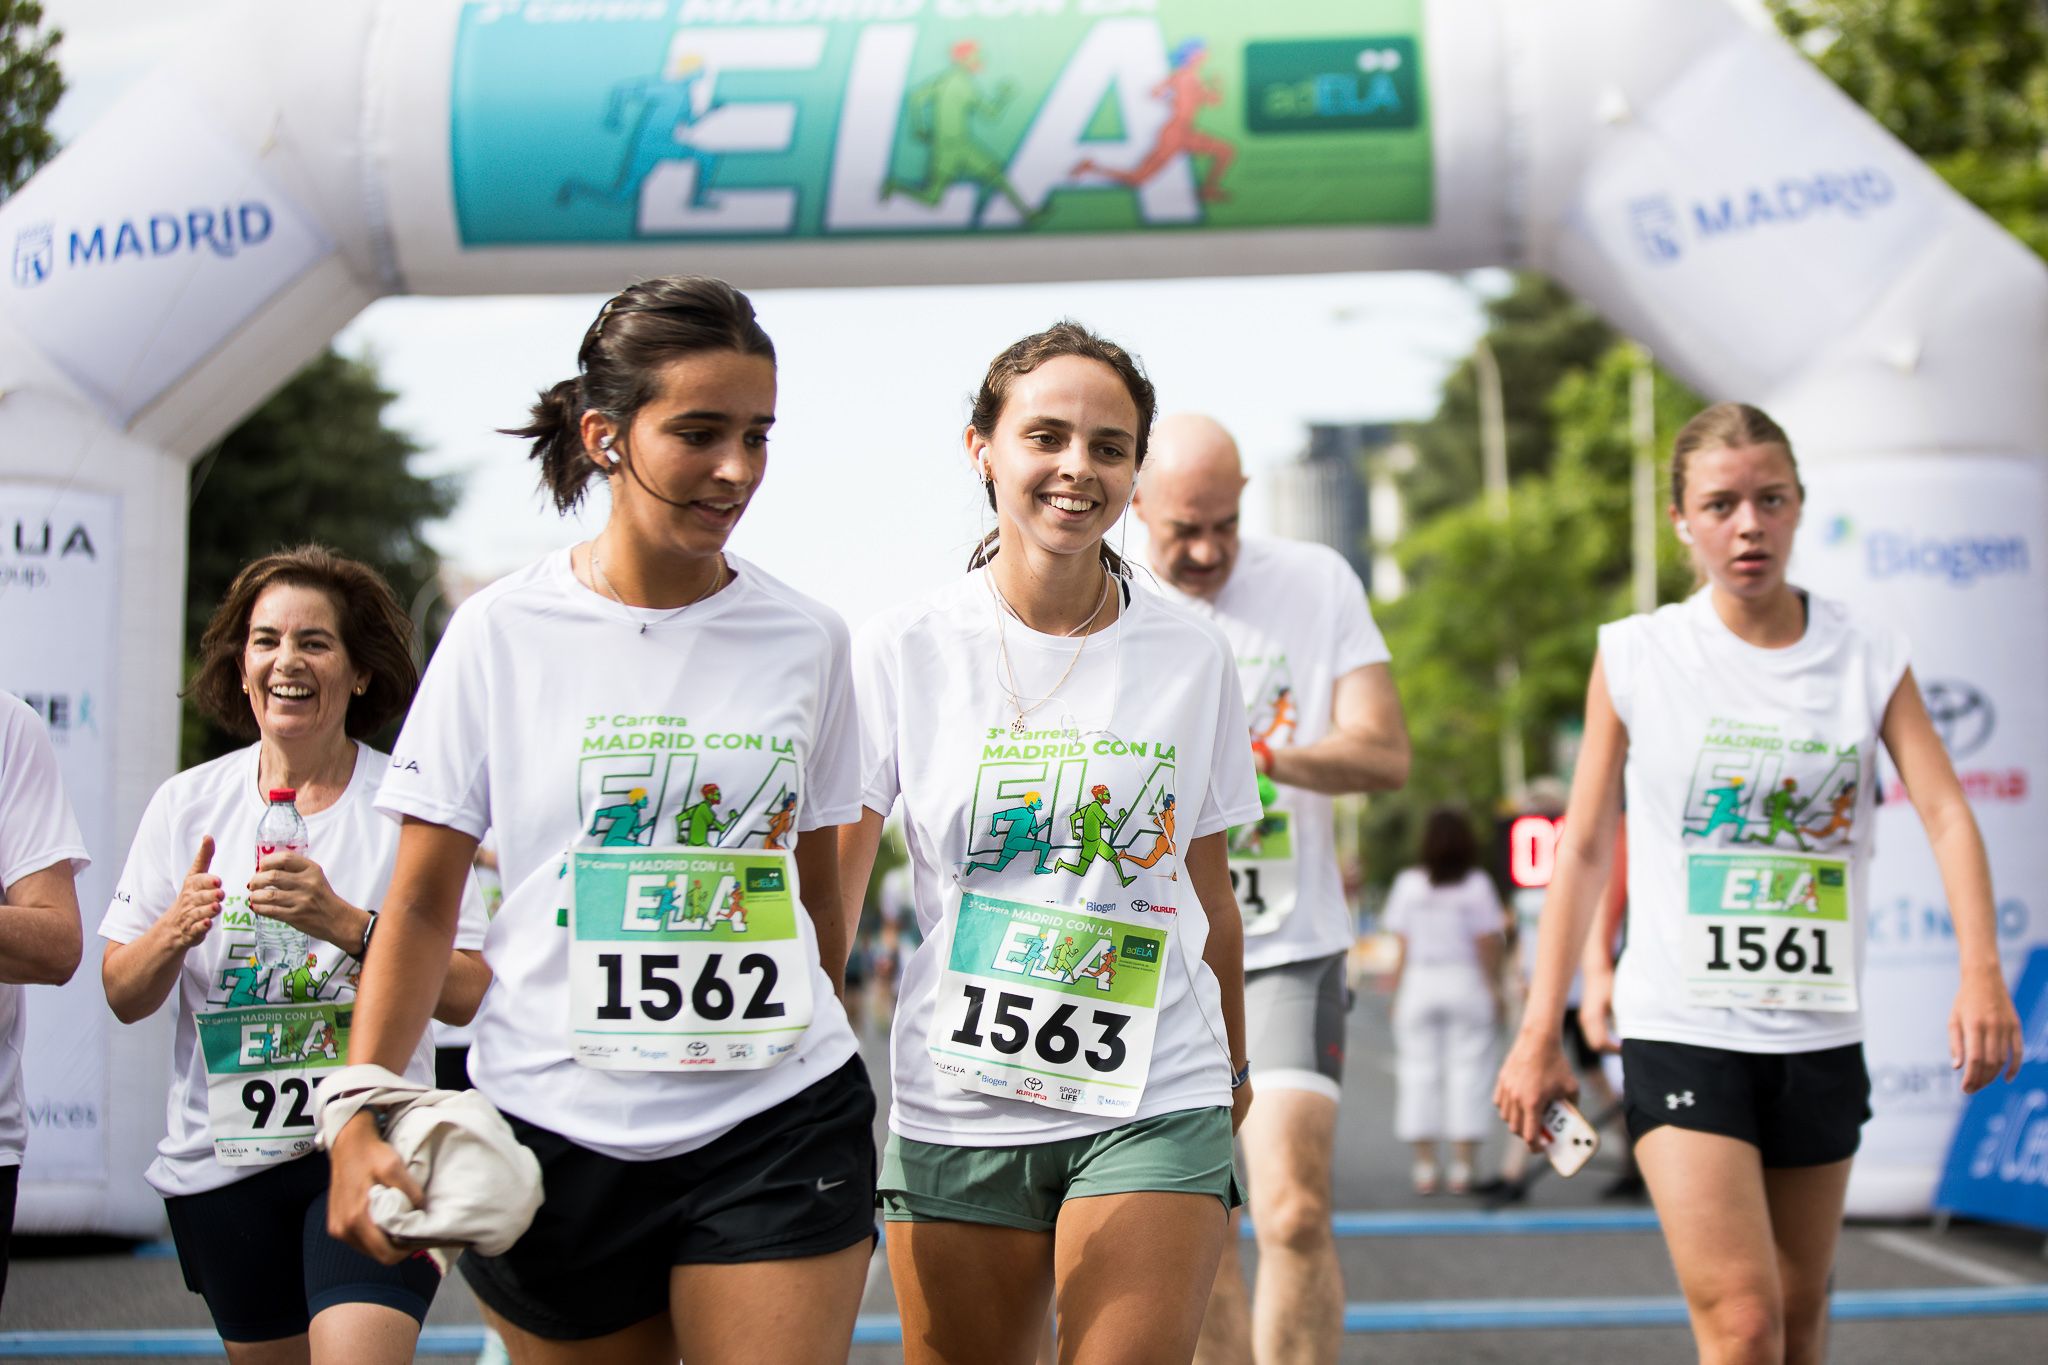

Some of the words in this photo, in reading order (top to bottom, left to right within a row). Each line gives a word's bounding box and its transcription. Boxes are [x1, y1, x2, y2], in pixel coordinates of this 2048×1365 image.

[636, 18, 1206, 236] ELA
[1692, 168, 1892, 236] MADRID
[69, 201, 273, 264] MADRID
[1865, 531, 2029, 588] Biogen
[582, 731, 696, 752] MADRID
[704, 733, 762, 751] CON
[770, 735, 796, 756] LA
[611, 714, 687, 728] Carrera
[1009, 727, 1080, 741] Carrera
[982, 741, 1087, 761] MADRID
[1092, 739, 1148, 758] CON
[1153, 742, 1176, 762] LA
[1703, 733, 1783, 750] MADRID
[1788, 740, 1829, 755] CON
[1836, 743, 1858, 757] LA
[967, 758, 1177, 857] ELA
[1683, 748, 1860, 826] ELA
[629, 860, 689, 873] MADRID
[690, 861, 717, 873] CON
[718, 861, 736, 873] LA
[1509, 815, 1567, 888] 0
[620, 873, 748, 932] ELA
[1086, 900, 1117, 914] Biogen
[1720, 868, 1820, 914] ELA
[979, 902, 1010, 916] Carrera
[1012, 908, 1064, 929] MADRID
[1066, 919, 1095, 935] CON
[1096, 925, 1114, 938] LA
[990, 919, 1114, 992] ELA
[1126, 946, 1154, 958] adELA
[1707, 925, 1833, 975] 1561
[597, 952, 786, 1021] 1562
[240, 1013, 283, 1024] MADRID
[285, 1012, 307, 1021] CON
[309, 1010, 324, 1020] LA
[950, 984, 1132, 1073] 1563
[238, 1020, 339, 1066] ELA
[241, 1078, 327, 1129] 92
[981, 1074, 1008, 1087] Biogen
[1060, 1086, 1081, 1095] SPORT
[1060, 1093, 1078, 1102] LIFE
